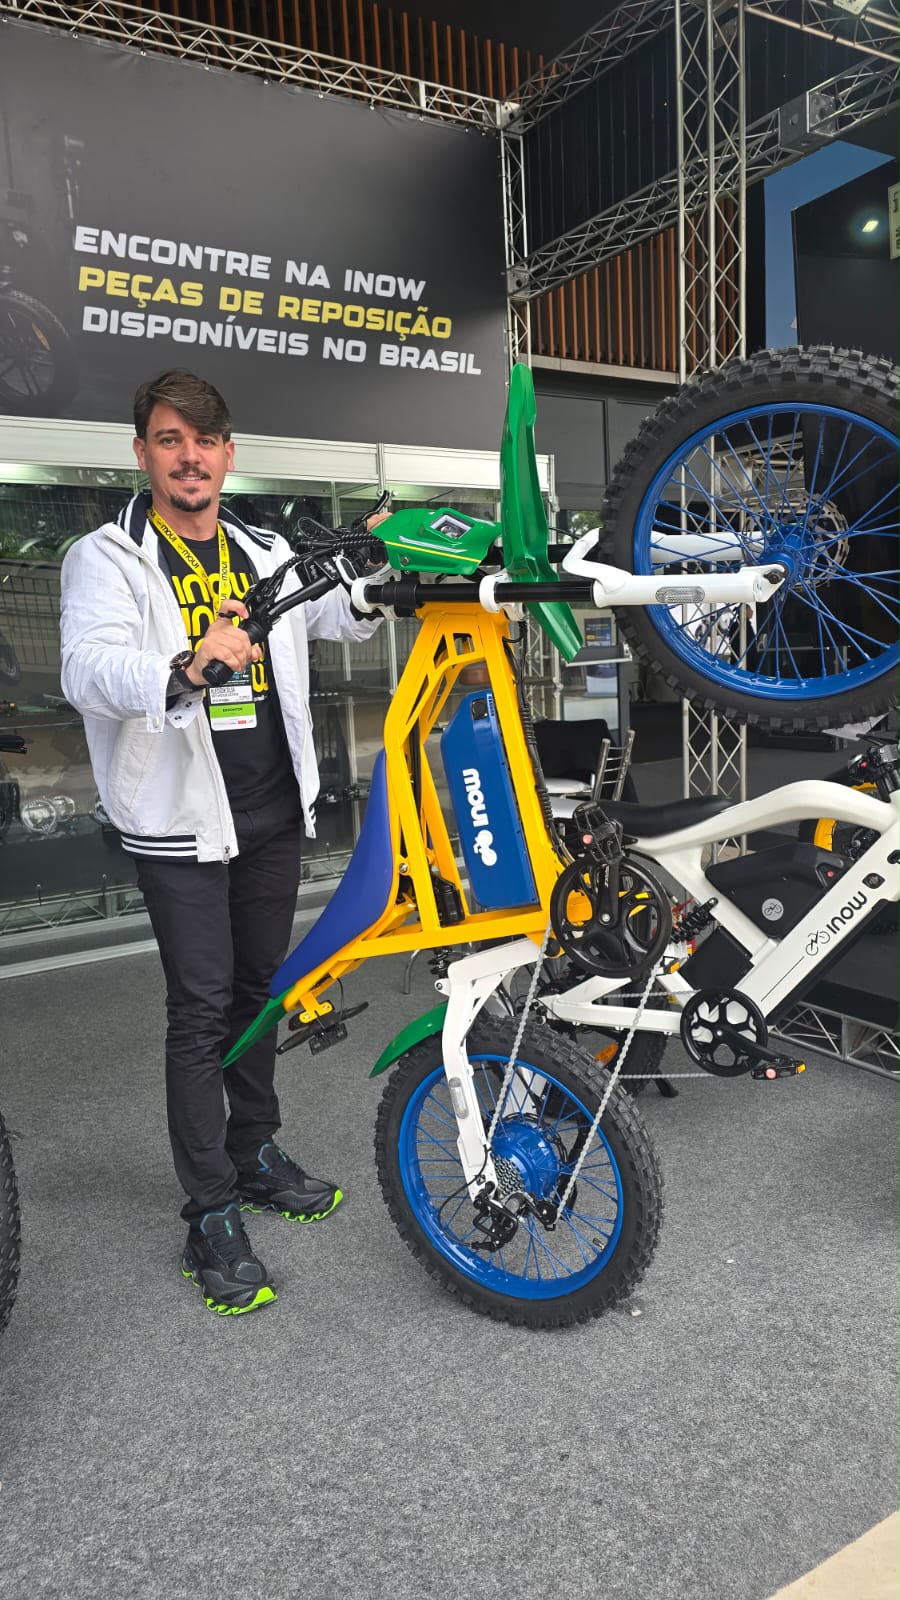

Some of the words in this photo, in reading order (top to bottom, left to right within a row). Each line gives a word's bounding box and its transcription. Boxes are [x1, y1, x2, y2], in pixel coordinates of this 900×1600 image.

[74, 225, 272, 280] ENCONTRE
[285, 260, 331, 289] NA
[344, 269, 426, 301] INOW
[78, 266, 204, 309] PEÇAS
[219, 286, 265, 315] DE
[278, 295, 452, 341] REPOSIÇÃO
[82, 306, 309, 356] DISPONÍVEIS
[322, 336, 367, 363] NO
[379, 343, 482, 375] BRASIL
